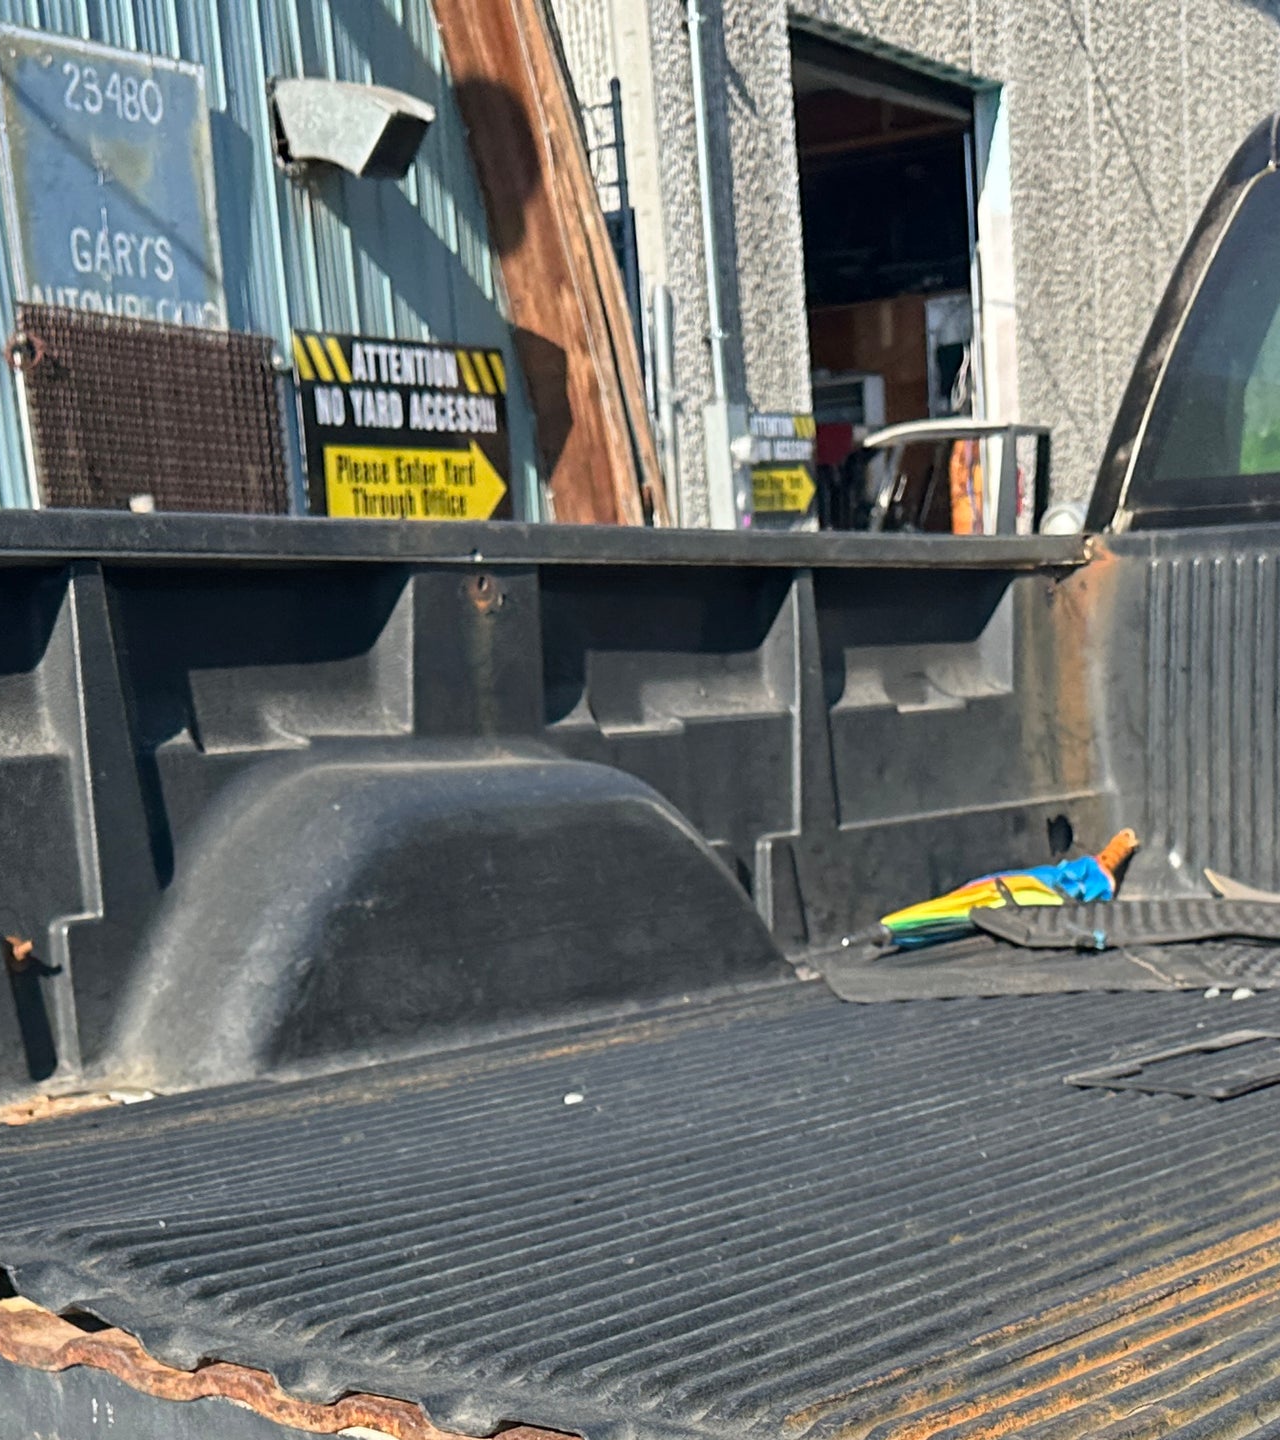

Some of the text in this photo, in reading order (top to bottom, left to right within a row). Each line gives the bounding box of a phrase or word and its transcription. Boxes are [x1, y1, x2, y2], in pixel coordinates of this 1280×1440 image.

[62, 62, 163, 125] 23480
[70, 226, 174, 282] GARYS
[351, 342, 459, 388] ATTENTION
[313, 385, 346, 427] NO
[349, 386, 404, 430] YARD
[335, 454, 477, 488] Please Enter Yard
[351, 486, 468, 518] Through Office
